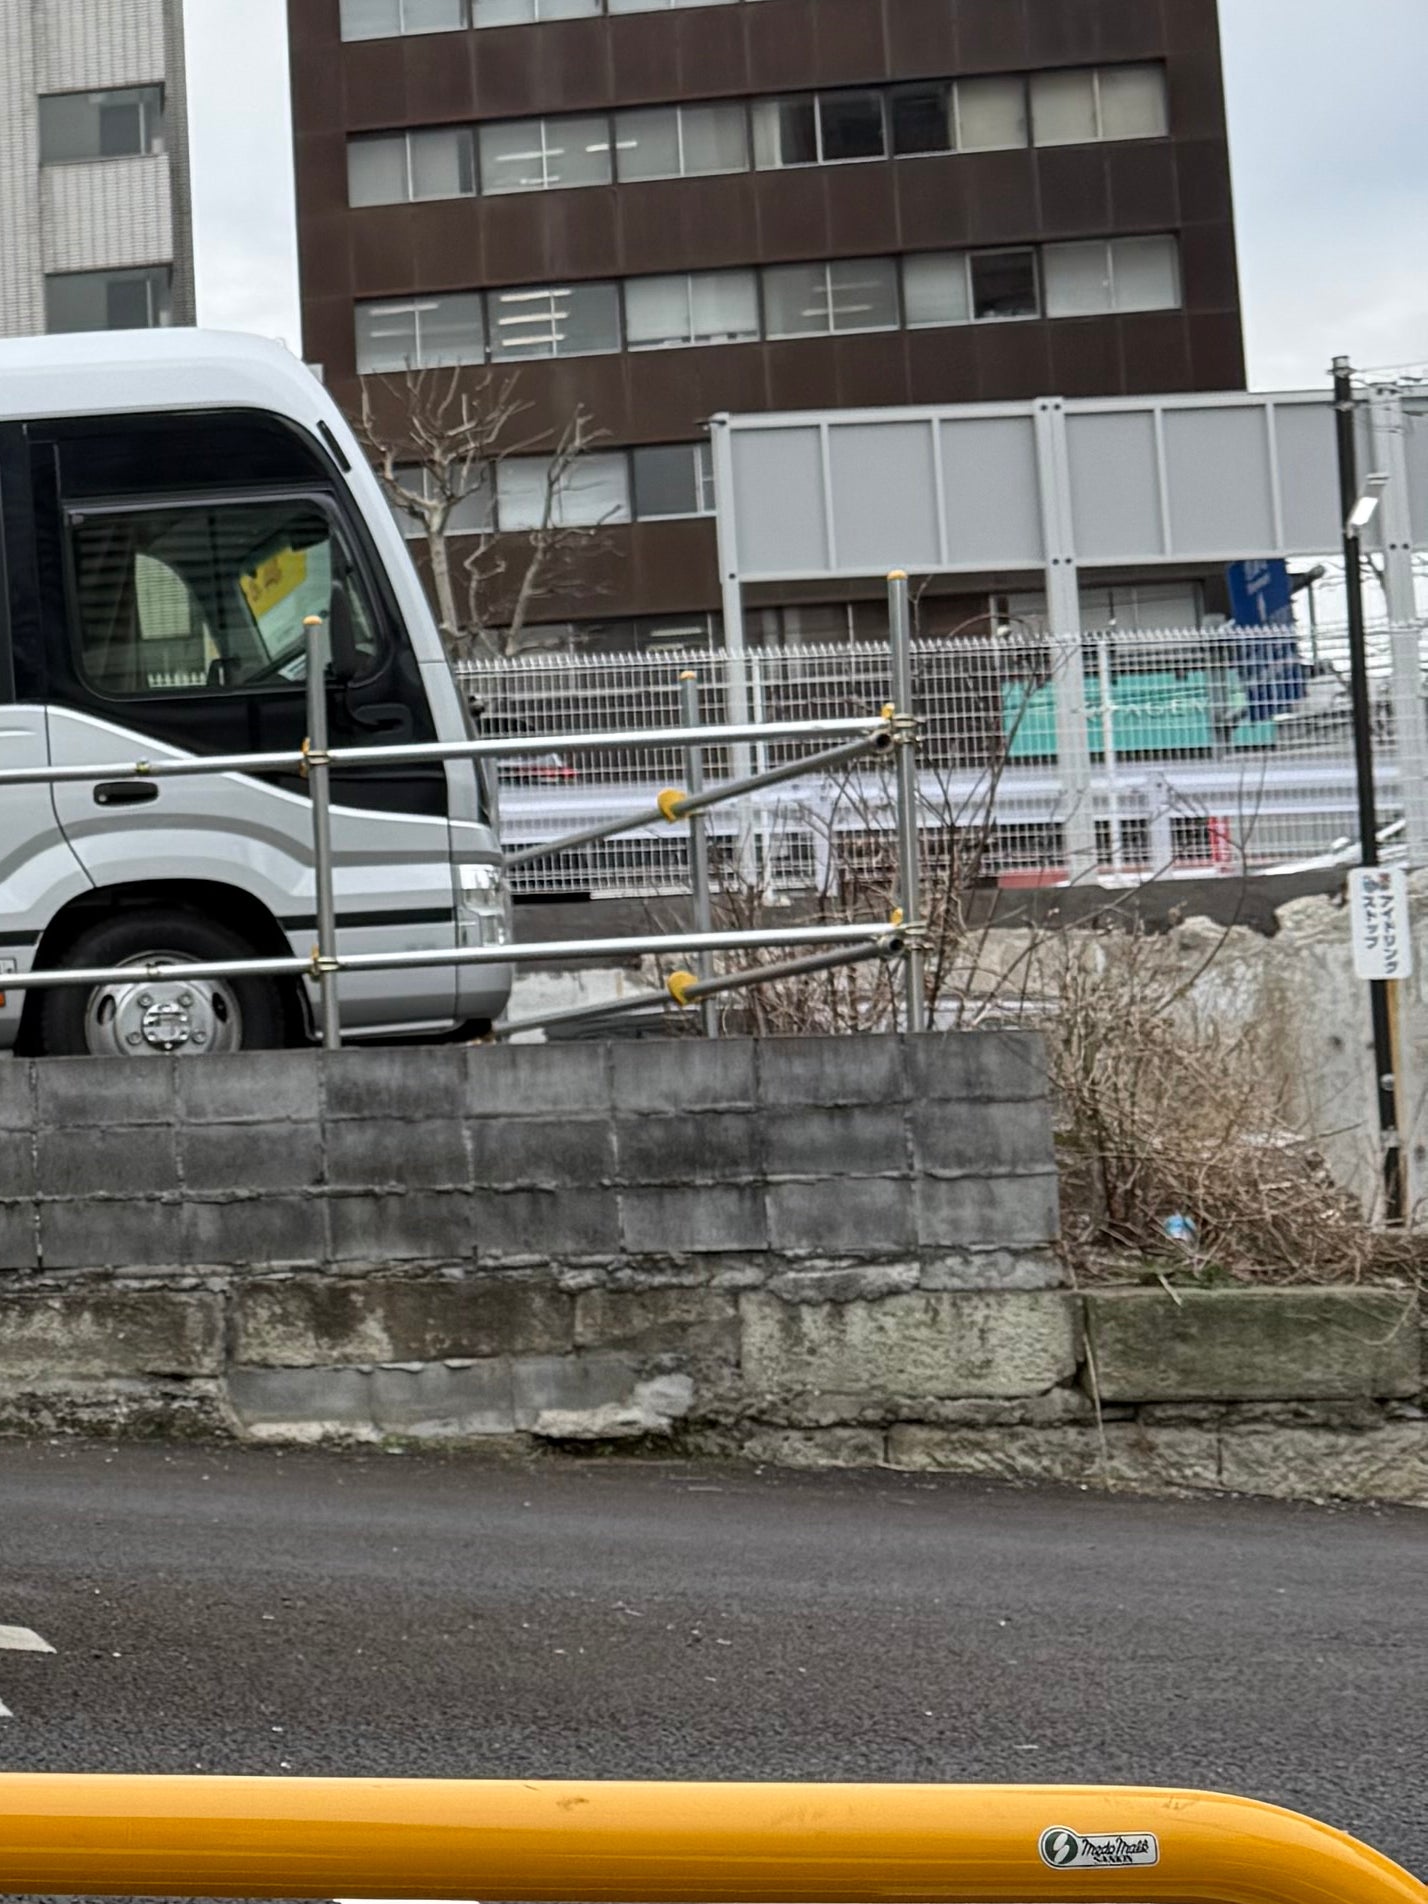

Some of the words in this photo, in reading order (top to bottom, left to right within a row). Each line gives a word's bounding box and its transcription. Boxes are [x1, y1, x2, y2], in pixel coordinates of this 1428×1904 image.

[1362, 896, 1379, 949] ストップ
[1379, 895, 1399, 974] アイドリング
